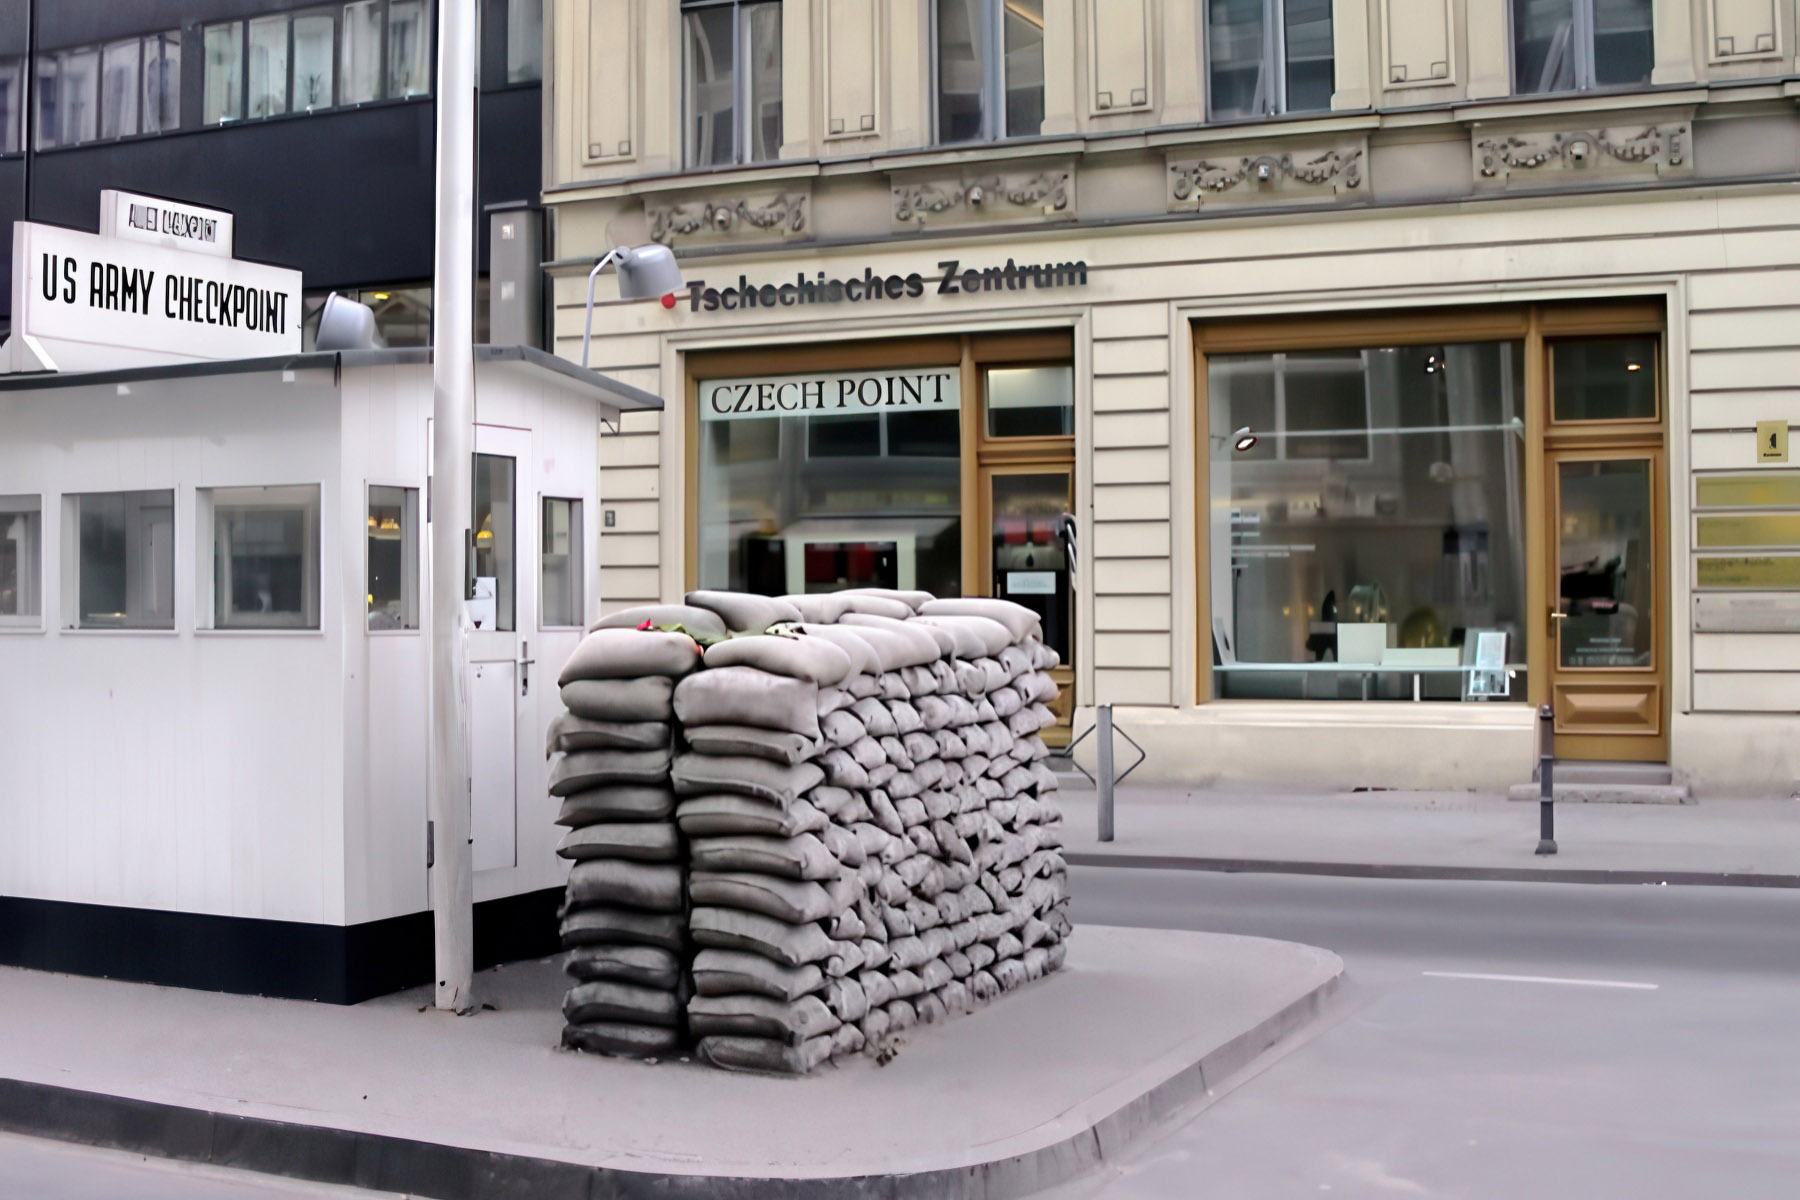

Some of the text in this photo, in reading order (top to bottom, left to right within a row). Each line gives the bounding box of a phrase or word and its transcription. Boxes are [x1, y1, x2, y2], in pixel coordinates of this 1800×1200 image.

[42, 253, 288, 335] US ARMY CHECKPOINT
[686, 258, 1088, 312] Tschechisches Zentrum
[711, 373, 951, 414] CZECH POINT
